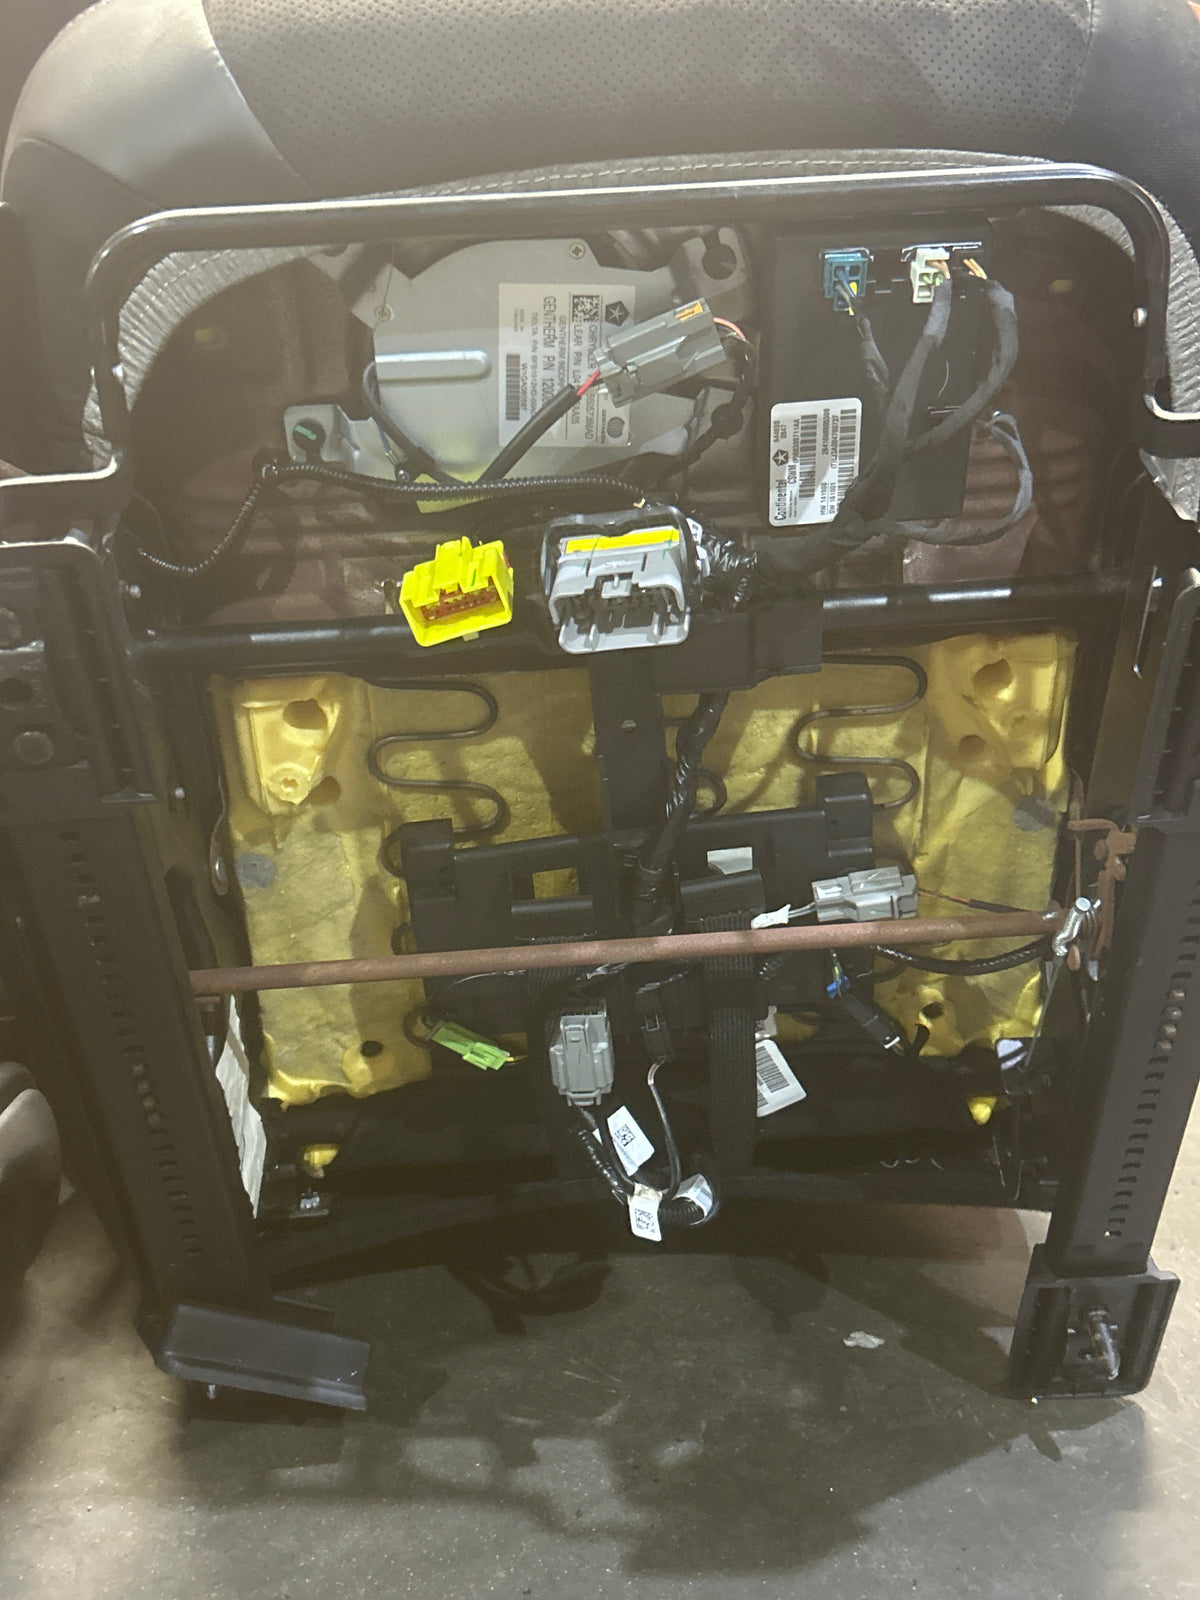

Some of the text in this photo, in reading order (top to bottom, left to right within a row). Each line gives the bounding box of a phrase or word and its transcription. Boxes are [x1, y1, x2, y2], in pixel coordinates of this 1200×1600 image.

[543, 296, 556, 347] GENTHERM
[573, 324, 581, 346] LEAR
[543, 356, 554, 371] P/N
[788, 465, 797, 484] CSWM
[775, 479, 787, 520] Continental
